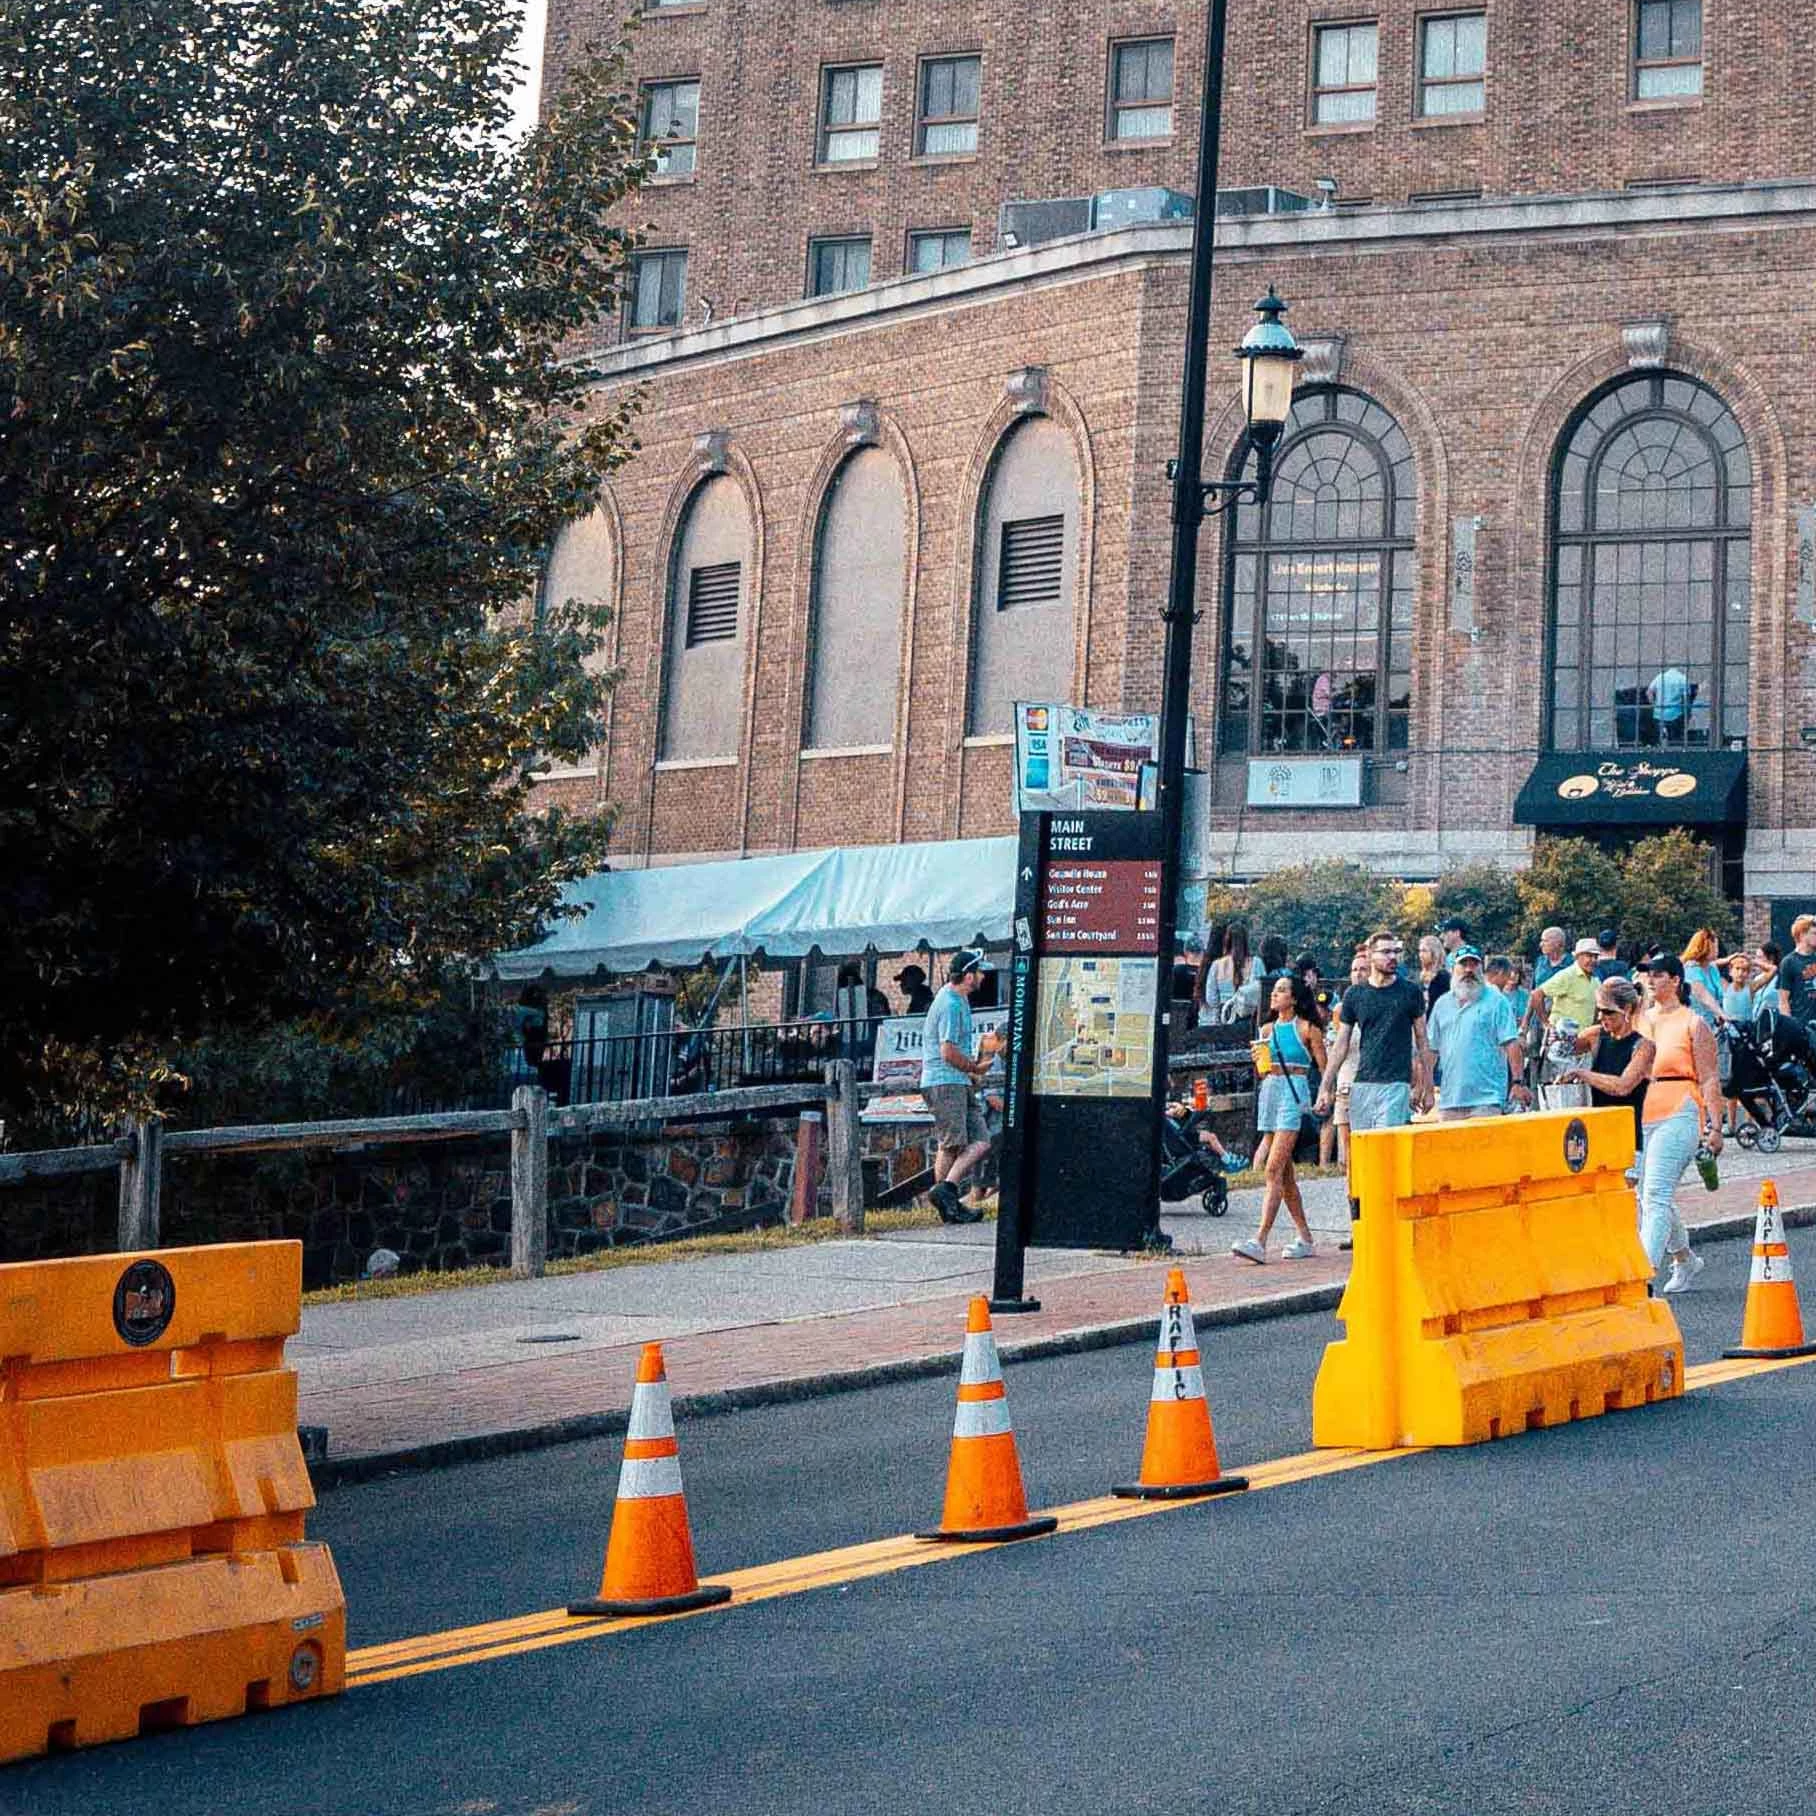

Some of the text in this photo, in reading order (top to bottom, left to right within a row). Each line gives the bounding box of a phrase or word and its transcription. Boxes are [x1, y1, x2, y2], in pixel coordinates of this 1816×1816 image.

[1050, 820, 1084, 834] MAIN
[1049, 837, 1093, 851] STREET
[1048, 884, 1103, 895] Visitor Center
[1047, 899, 1069, 909] God's
[1046, 915, 1061, 924] Sun
[1077, 930, 1117, 942] Courtyard
[1013, 975, 1026, 1052] MORAVIAN
[1169, 1291, 1186, 1401] TRAFFIC
